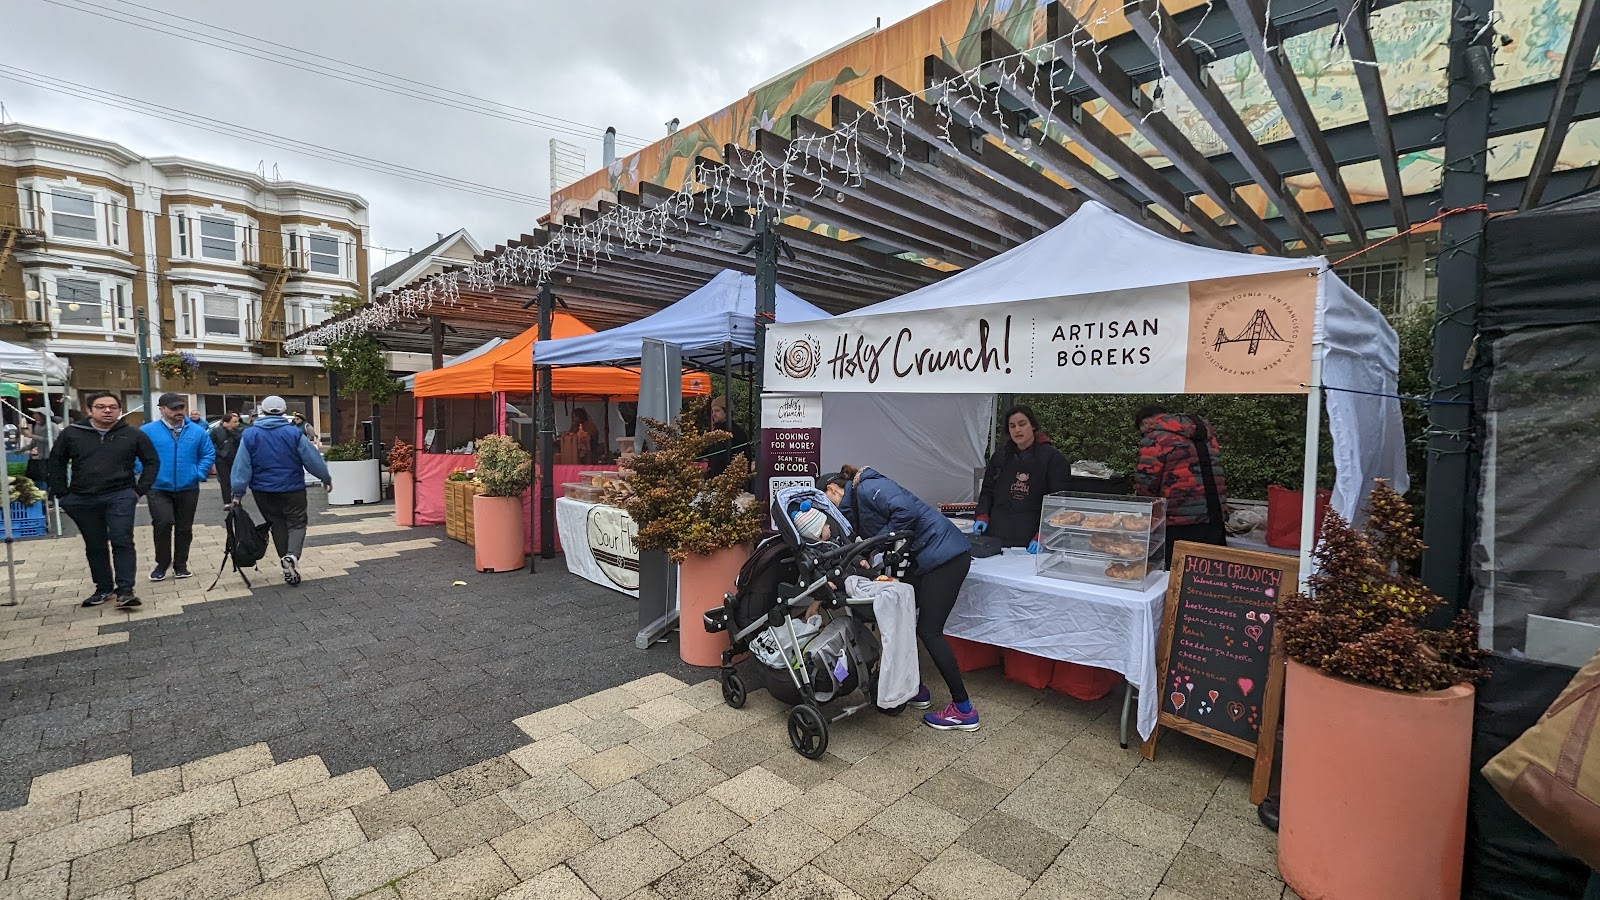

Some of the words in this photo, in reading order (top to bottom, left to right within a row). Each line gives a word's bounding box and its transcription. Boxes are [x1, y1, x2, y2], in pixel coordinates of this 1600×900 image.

[1216, 292, 1261, 310] CALIFORNIA
[1268, 294, 1282, 303] SAN
[1051, 317, 1158, 342] ARTISAN
[1204, 313, 1215, 330] AREA
[1282, 302, 1299, 339] FRANCISCO
[827, 333, 892, 384] Holy
[893, 314, 1012, 378] Crunch!
[1057, 344, 1151, 367] BÖREKS
[1283, 344, 1295, 358] BAY
[1205, 351, 1237, 375] FRANCISCO
[1263, 358, 1282, 371] AREA
[771, 441, 785, 449] FOR
[789, 441, 815, 450] MORE?
[775, 432, 810, 441] LOOKING
[774, 462, 785, 472] QR
[787, 463, 809, 473] CODE
[593, 511, 619, 550] Sour
[1185, 556, 1225, 577] HOLY
[1227, 563, 1282, 586] CRUNCH
